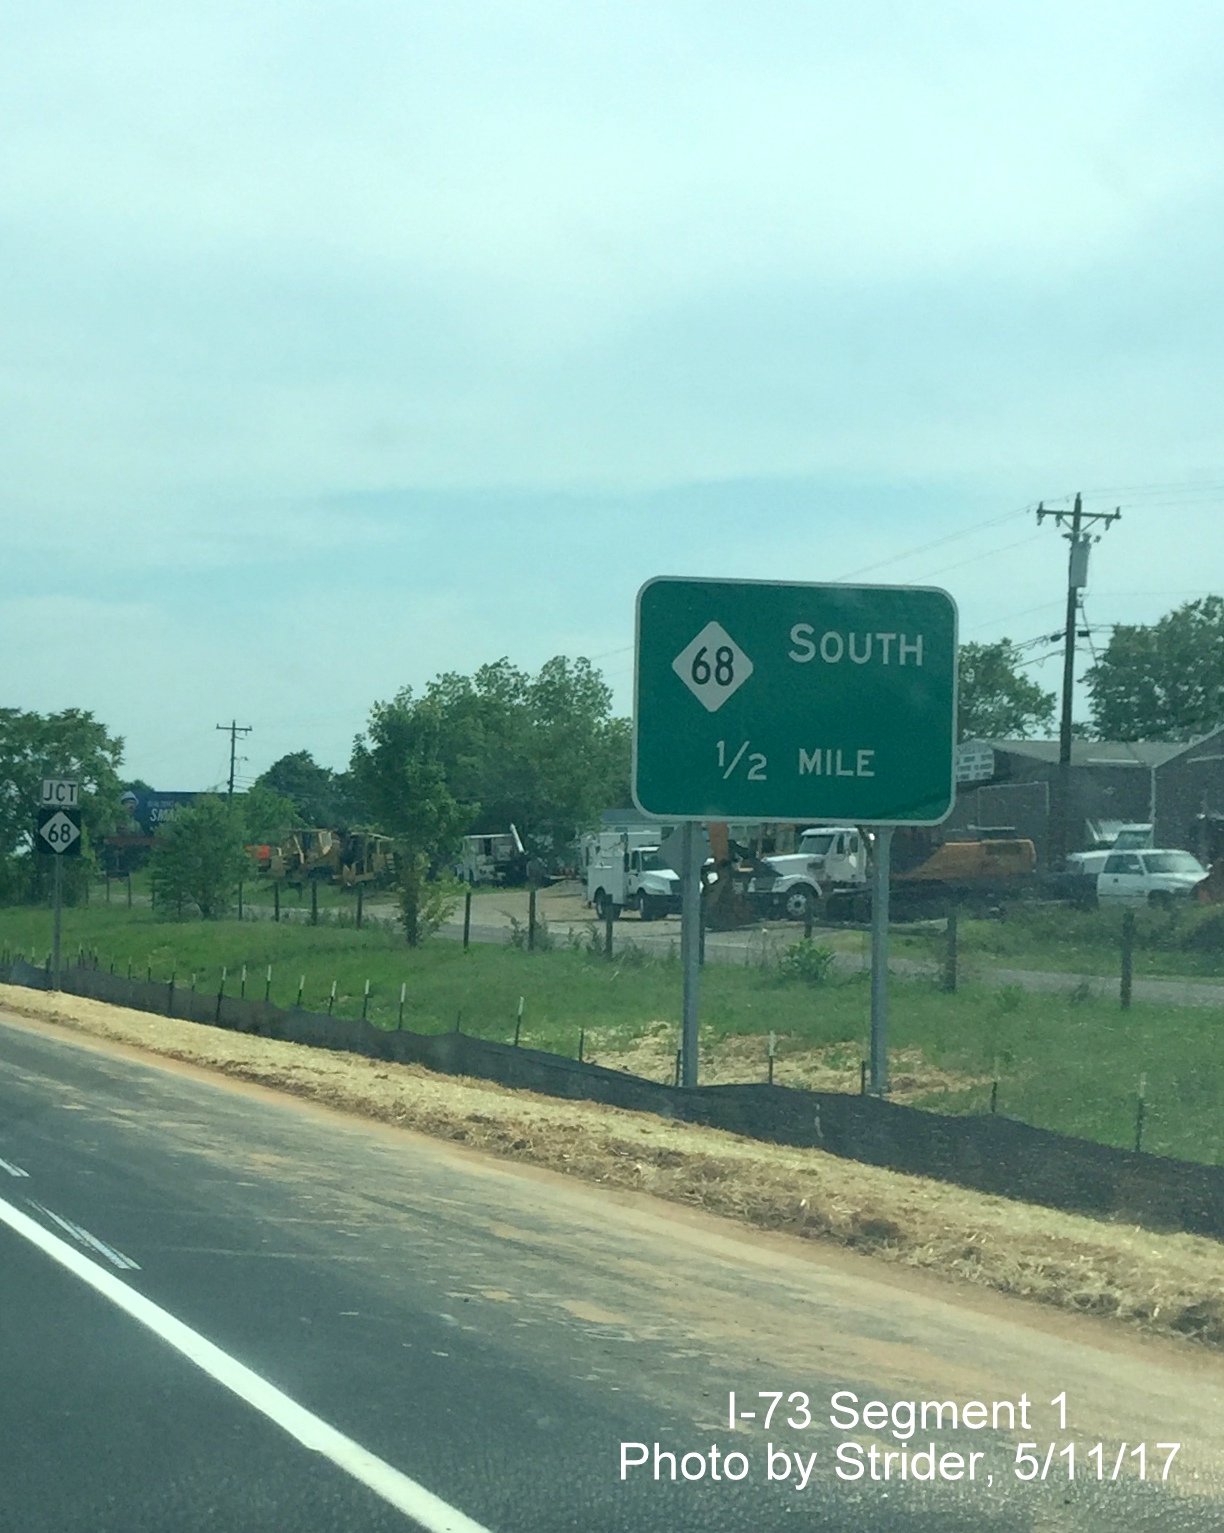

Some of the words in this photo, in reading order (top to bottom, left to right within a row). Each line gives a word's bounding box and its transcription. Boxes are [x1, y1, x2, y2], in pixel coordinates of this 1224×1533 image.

[788, 623, 924, 667] SOUTH
[691, 645, 734, 687] 68
[716, 740, 768, 781] 1/2
[798, 748, 876, 778] MILE
[43, 783, 77, 802] JCT
[47, 823, 72, 844] 68
